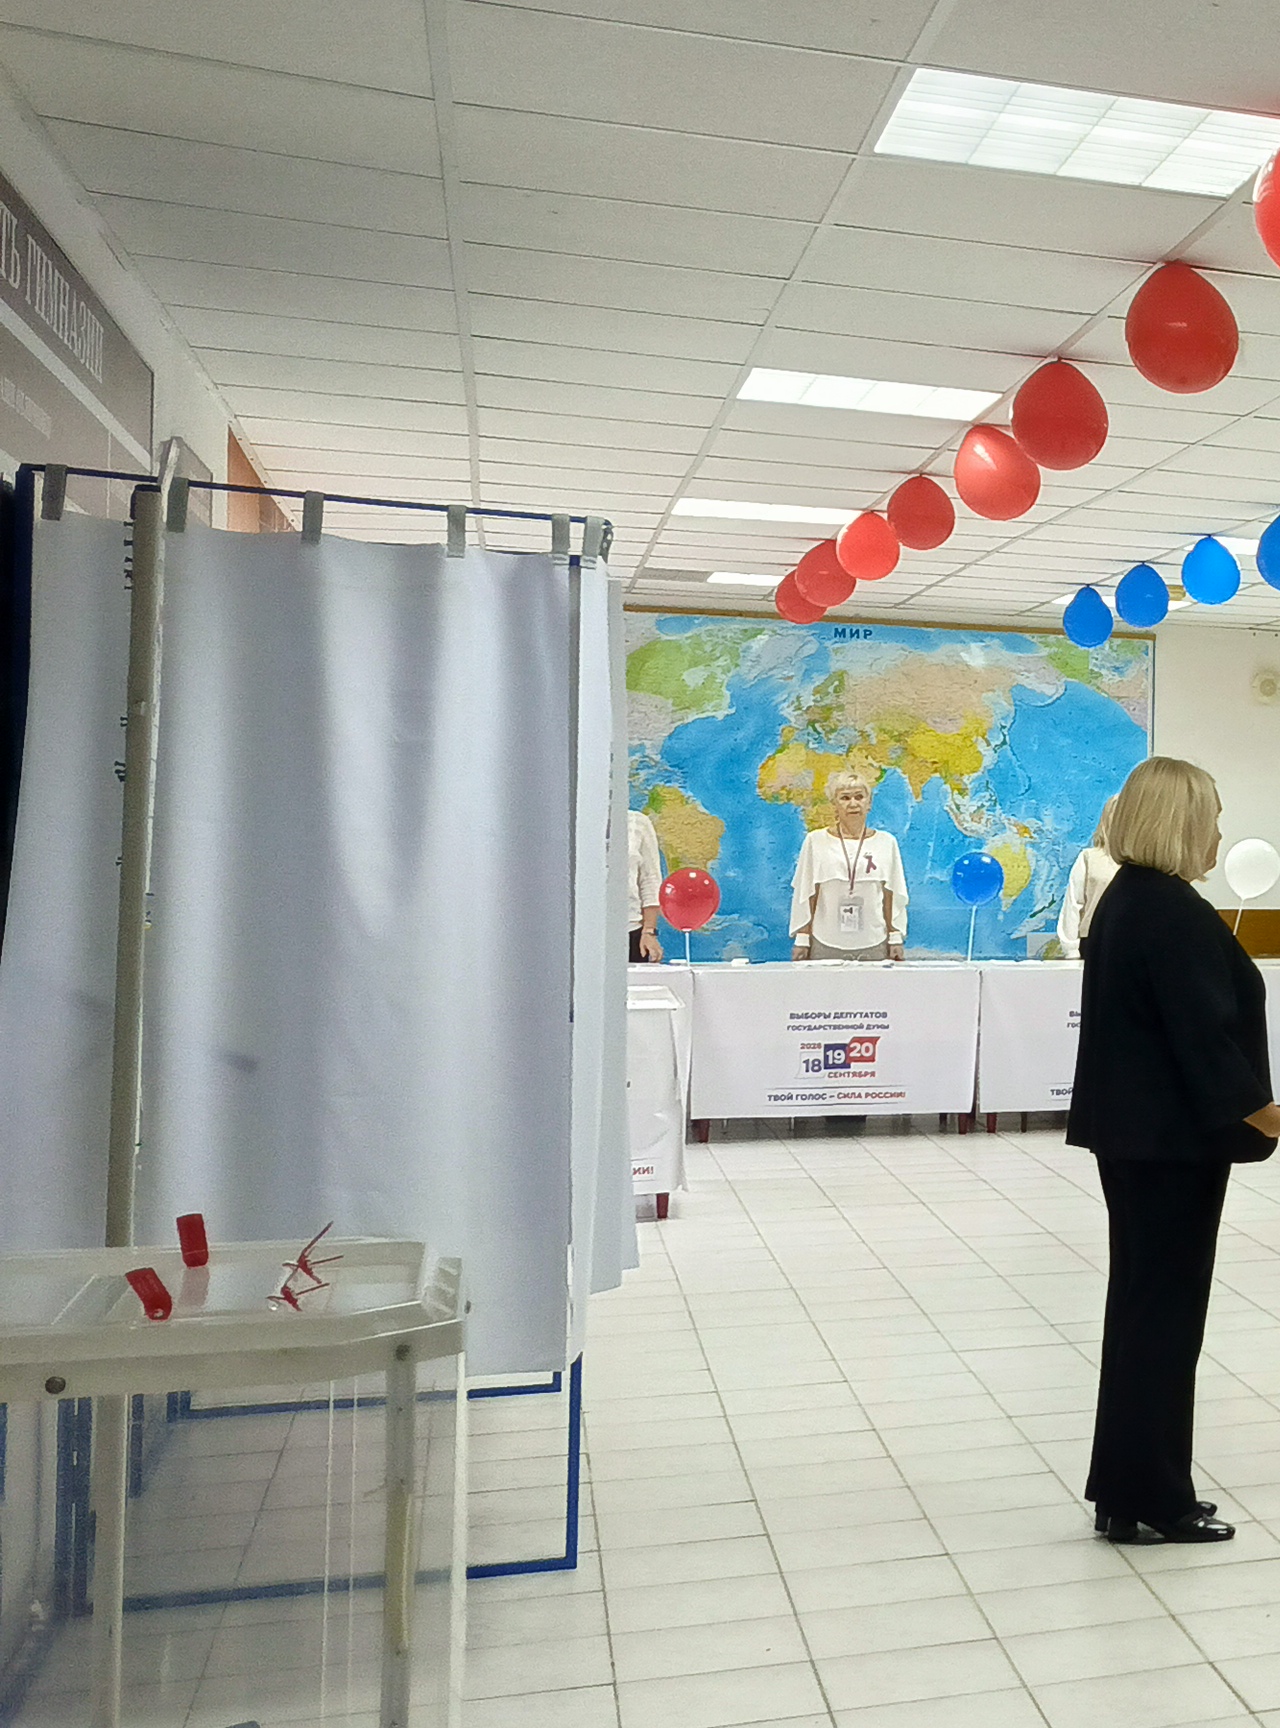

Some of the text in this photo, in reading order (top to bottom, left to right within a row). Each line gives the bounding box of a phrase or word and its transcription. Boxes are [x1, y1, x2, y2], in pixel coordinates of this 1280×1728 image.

[834, 627, 873, 639] МИР
[789, 1011, 888, 1020] ВЫБОРЫ ДЕПУТАТОВ
[803, 1042, 874, 1073] 18 19 20
[768, 1092, 793, 1101] ТВОЙ
[795, 1093, 827, 1101] ГОЛОС
